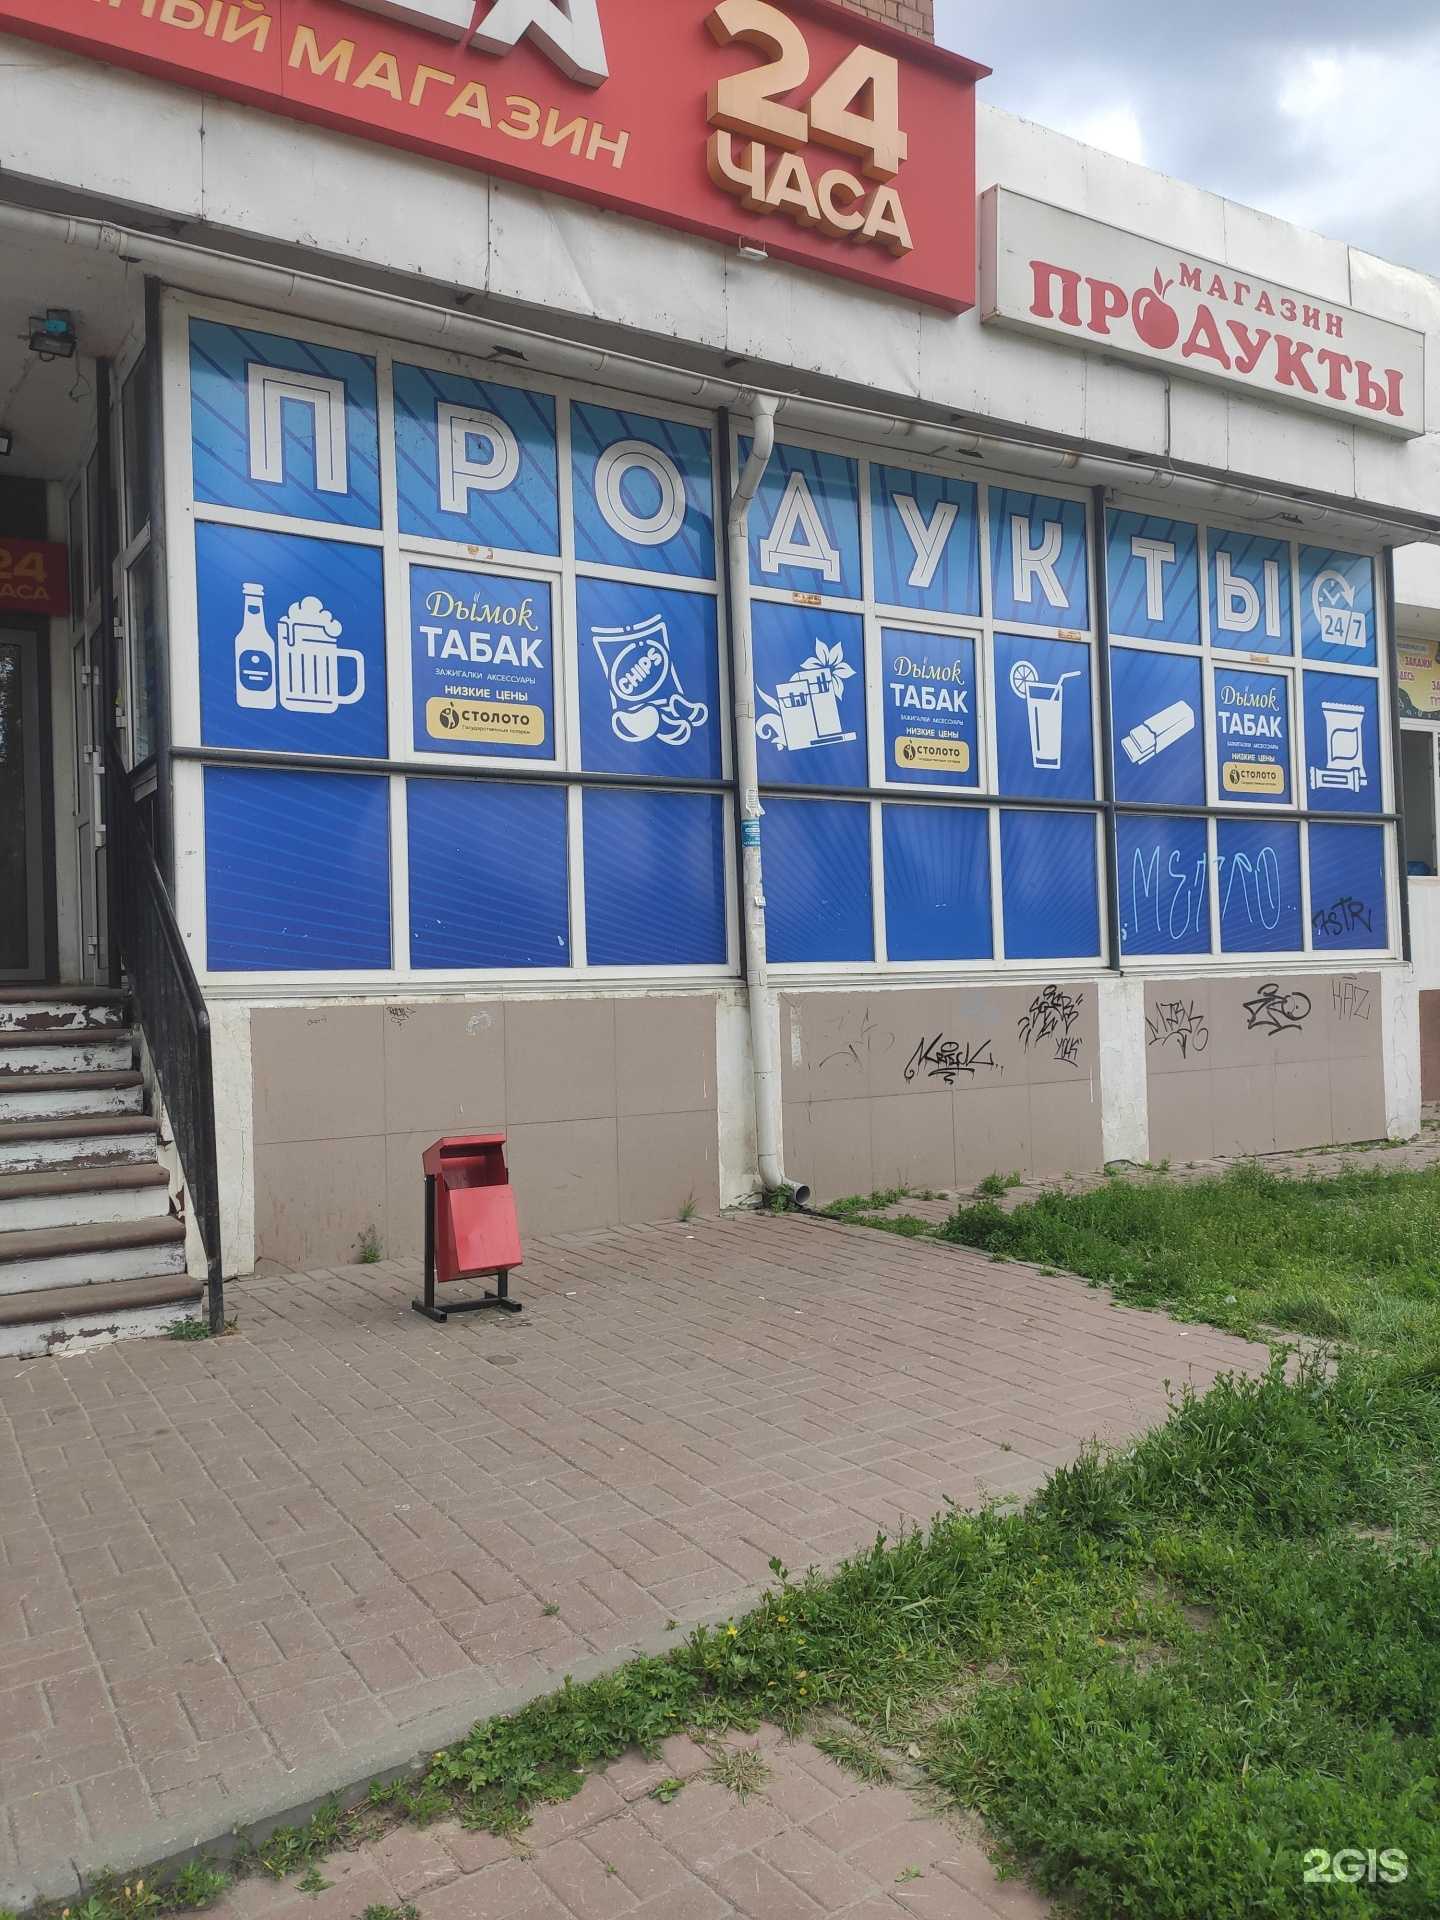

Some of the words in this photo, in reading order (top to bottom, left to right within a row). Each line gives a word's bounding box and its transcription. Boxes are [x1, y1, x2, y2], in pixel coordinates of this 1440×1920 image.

[287, 24, 630, 169] МАГАЗИН
[705, 0, 908, 184] 24
[706, 128, 914, 257] ЧАСА
[1178, 262, 1344, 339] МАГАЗИН
[1028, 259, 1404, 417] ПРОДУКТЫ
[425, 590, 539, 632] Дымок
[419, 625, 545, 669] ТАБАК
[434, 667, 483, 680] ЗАЖИГАЛКИ
[486, 673, 536, 685] АКСЕССУАРЫ
[618, 647, 662, 695] CHIPS
[444, 685, 491, 699] НИЗКИЕ
[496, 689, 529, 702] ЦЕНЫ
[889, 682, 969, 714] ТАБАК
[461, 709, 530, 727] СТОЛОТО
[906, 726, 936, 738] НИЗКИЕ
[938, 730, 960, 739] ЦЕНЫ
[1217, 710, 1283, 738] ТАБАК
[916, 745, 960, 758] СТОЛОТО
[1240, 770, 1277, 781] СТОЛОТО
